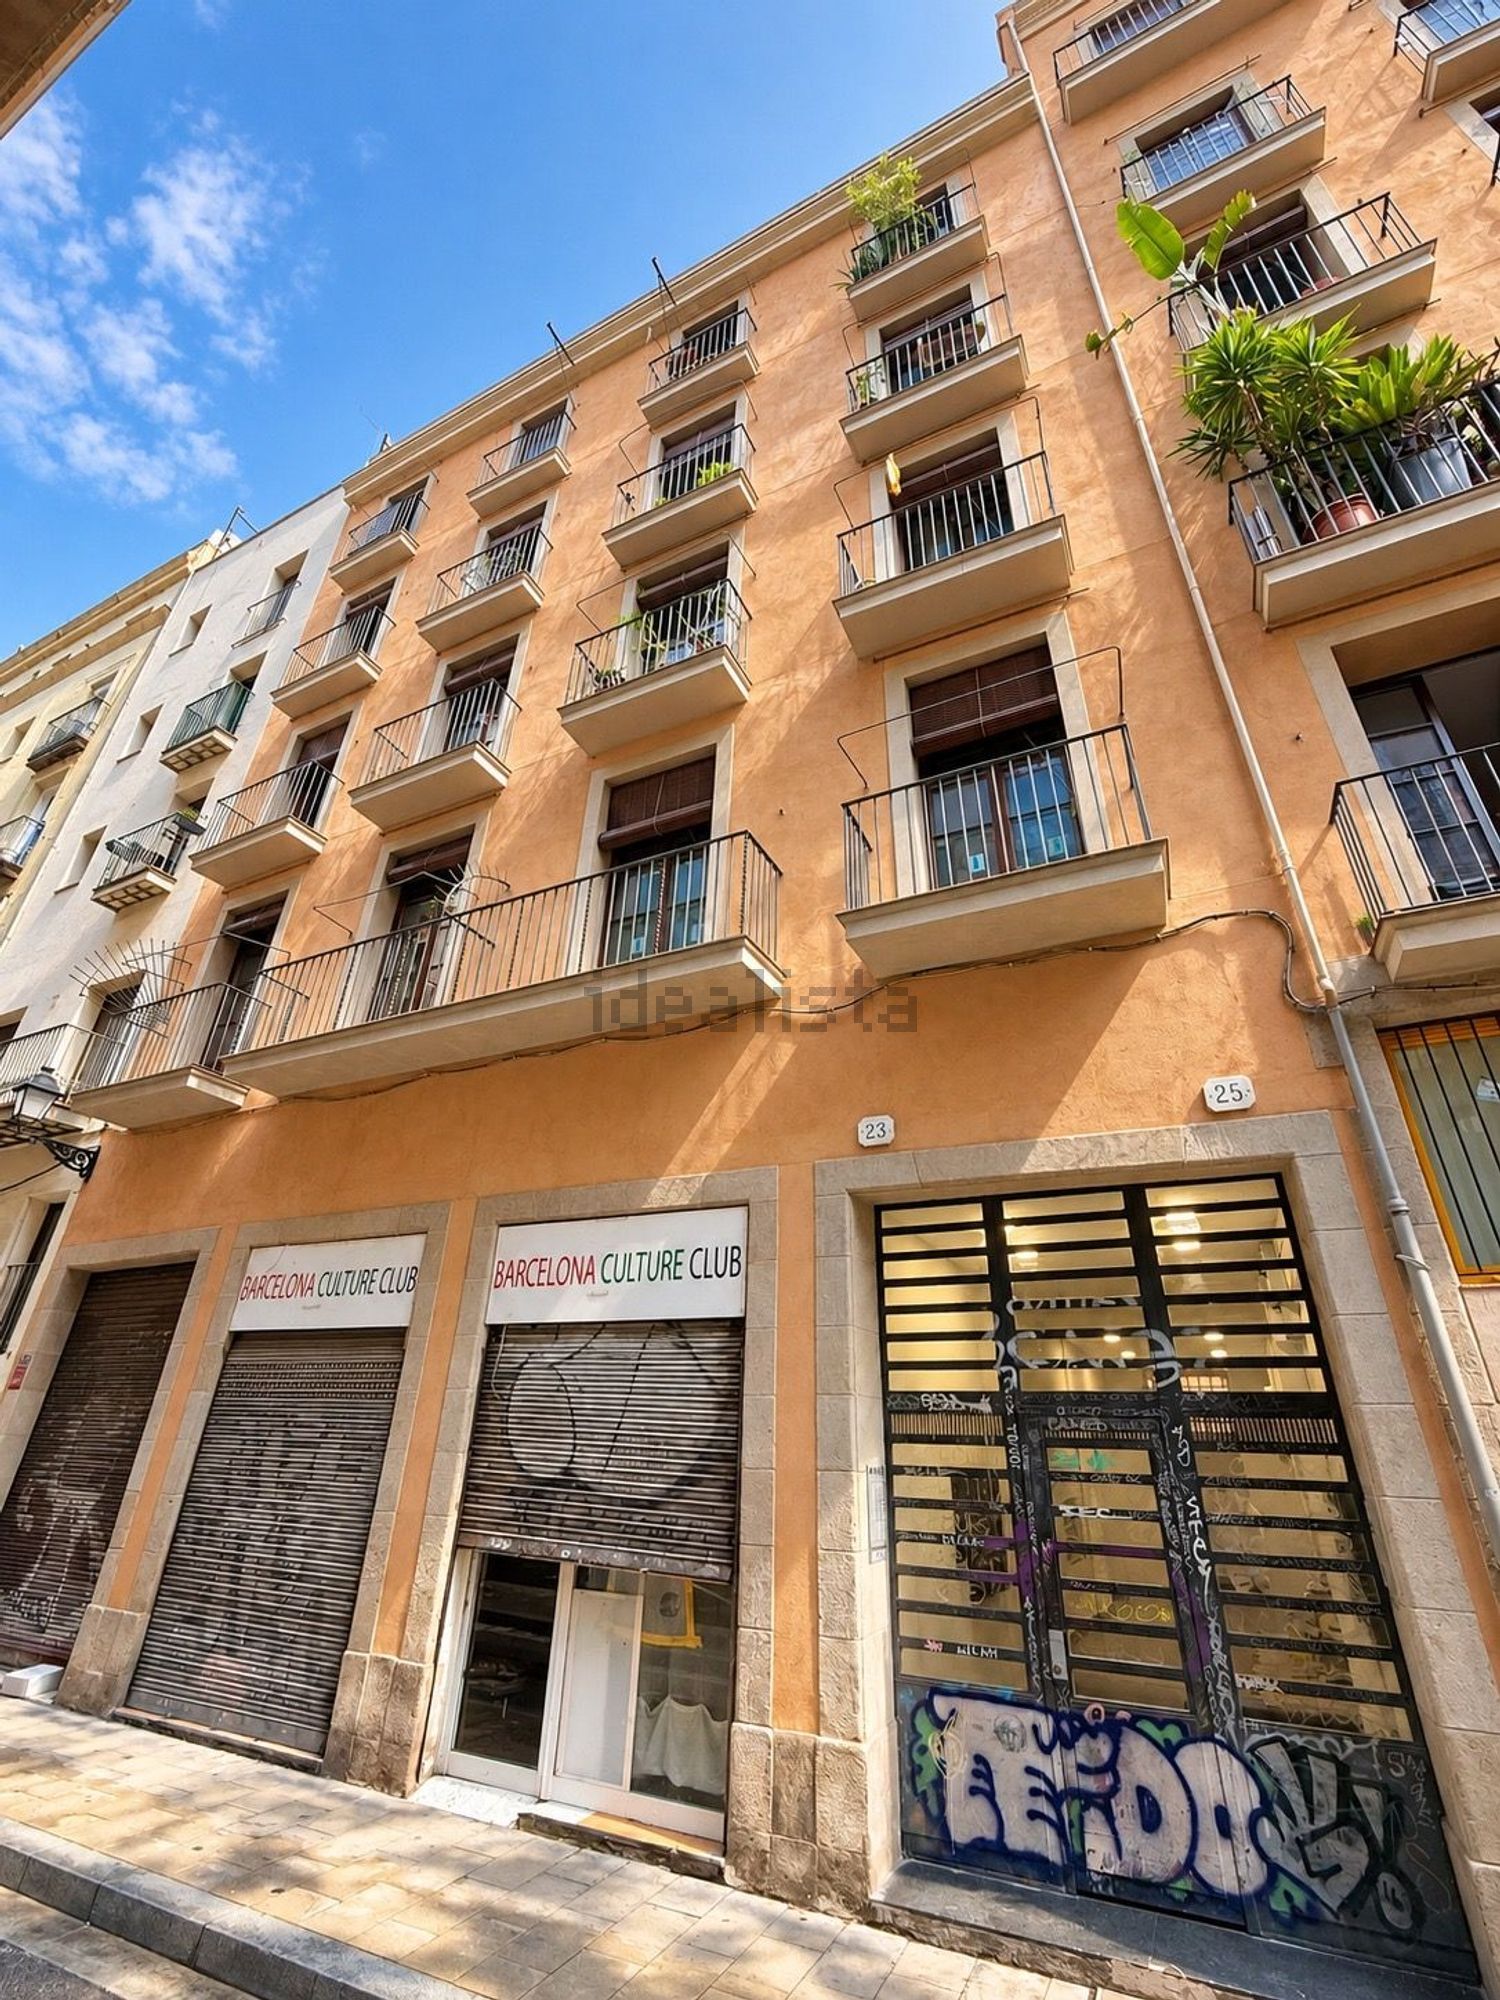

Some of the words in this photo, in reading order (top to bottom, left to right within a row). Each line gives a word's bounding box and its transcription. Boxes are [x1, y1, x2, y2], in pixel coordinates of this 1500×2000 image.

[1213, 1082, 1244, 1104] 25
[864, 1122, 887, 1140] 23
[493, 1254, 596, 1289] BARCELONA
[600, 1248, 685, 1284] CULTURE
[689, 1245, 742, 1279] CLUB
[240, 1272, 316, 1301] BARCELONA
[317, 1268, 379, 1297] CULTURE
[378, 1266, 419, 1294] CLUB
